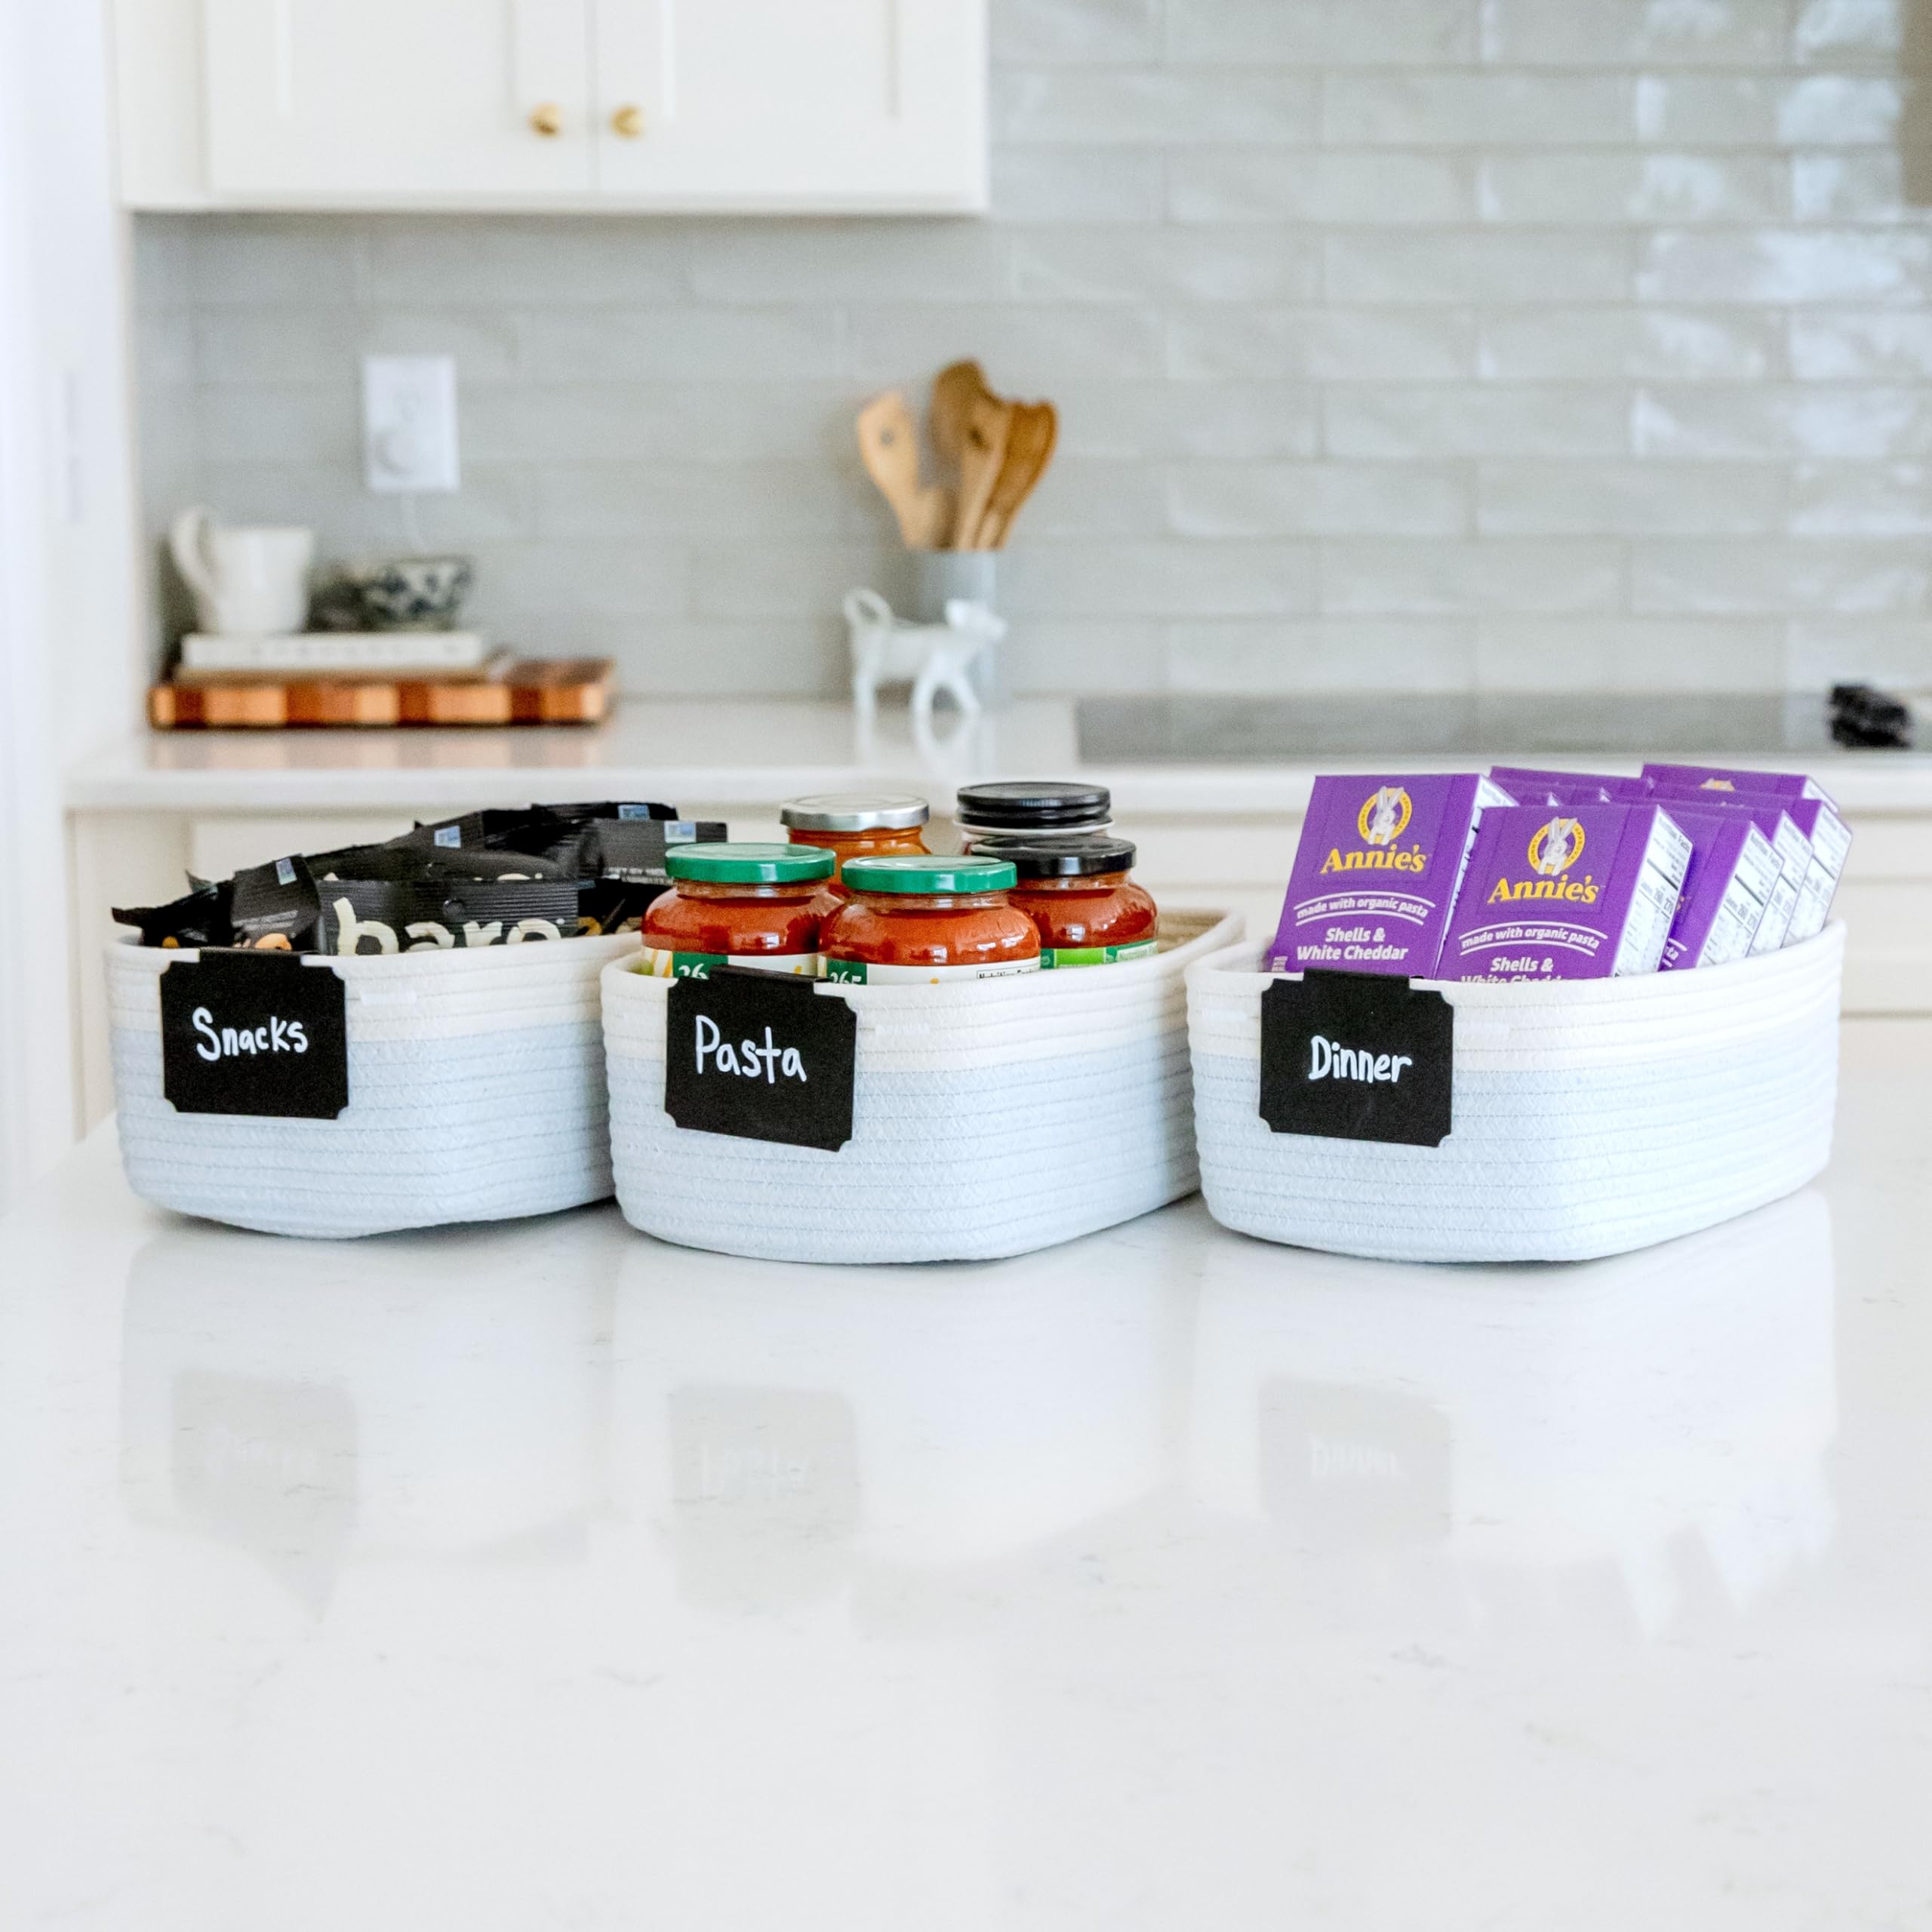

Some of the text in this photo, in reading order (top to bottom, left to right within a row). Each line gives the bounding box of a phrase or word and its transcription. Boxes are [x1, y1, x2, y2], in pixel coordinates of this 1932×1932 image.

[1319, 843, 1427, 875] Annie's
[1487, 874, 1599, 904] Annie's
[1297, 897, 1429, 919] made with organic pasta
[1324, 927, 1386, 943] Shells &
[1461, 927, 1601, 949] made with organic pasta
[1296, 945, 1409, 961] White Cheddar
[1489, 956, 1555, 973] Shells &
[192, 1006, 309, 1062] Snacks
[695, 1014, 808, 1084] Pasta
[1308, 1035, 1414, 1084] Dinner
